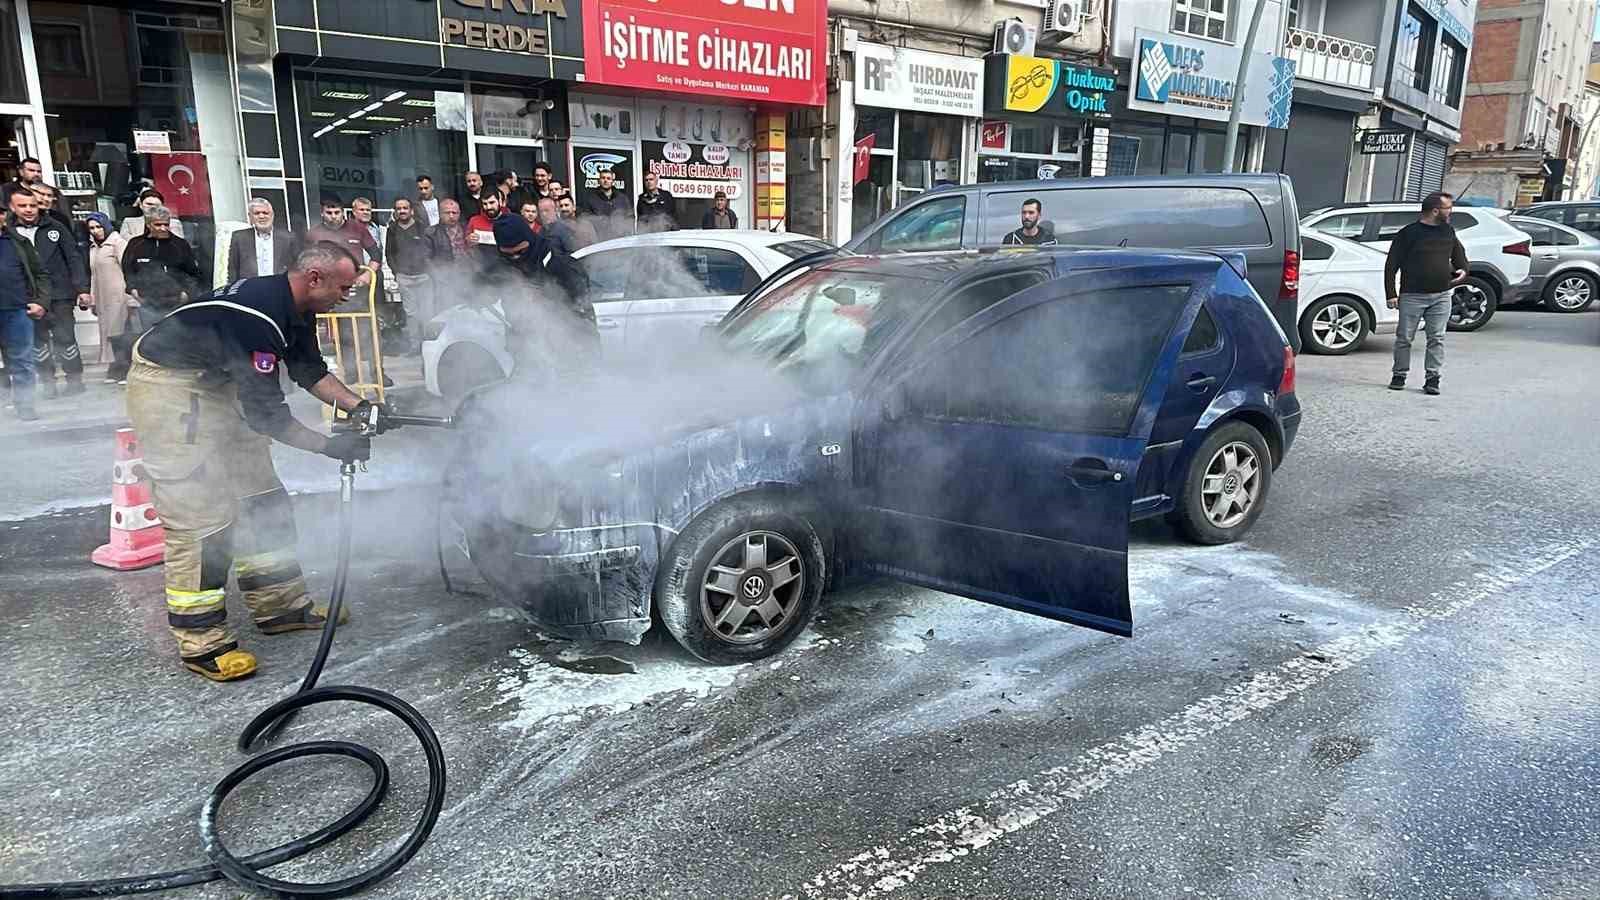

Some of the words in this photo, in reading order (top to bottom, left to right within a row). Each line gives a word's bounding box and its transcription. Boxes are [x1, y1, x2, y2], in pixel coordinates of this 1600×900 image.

[441, 17, 549, 53] PERDE
[603, 11, 690, 69] İŞİTME
[697, 28, 812, 81] CİHAZLARI
[908, 63, 978, 91] HIRDAVAT
[688, 161, 744, 179] CİHAZLARI
[672, 183, 695, 194] 0549
[697, 183, 712, 194] 678
[726, 185, 736, 195] 07
